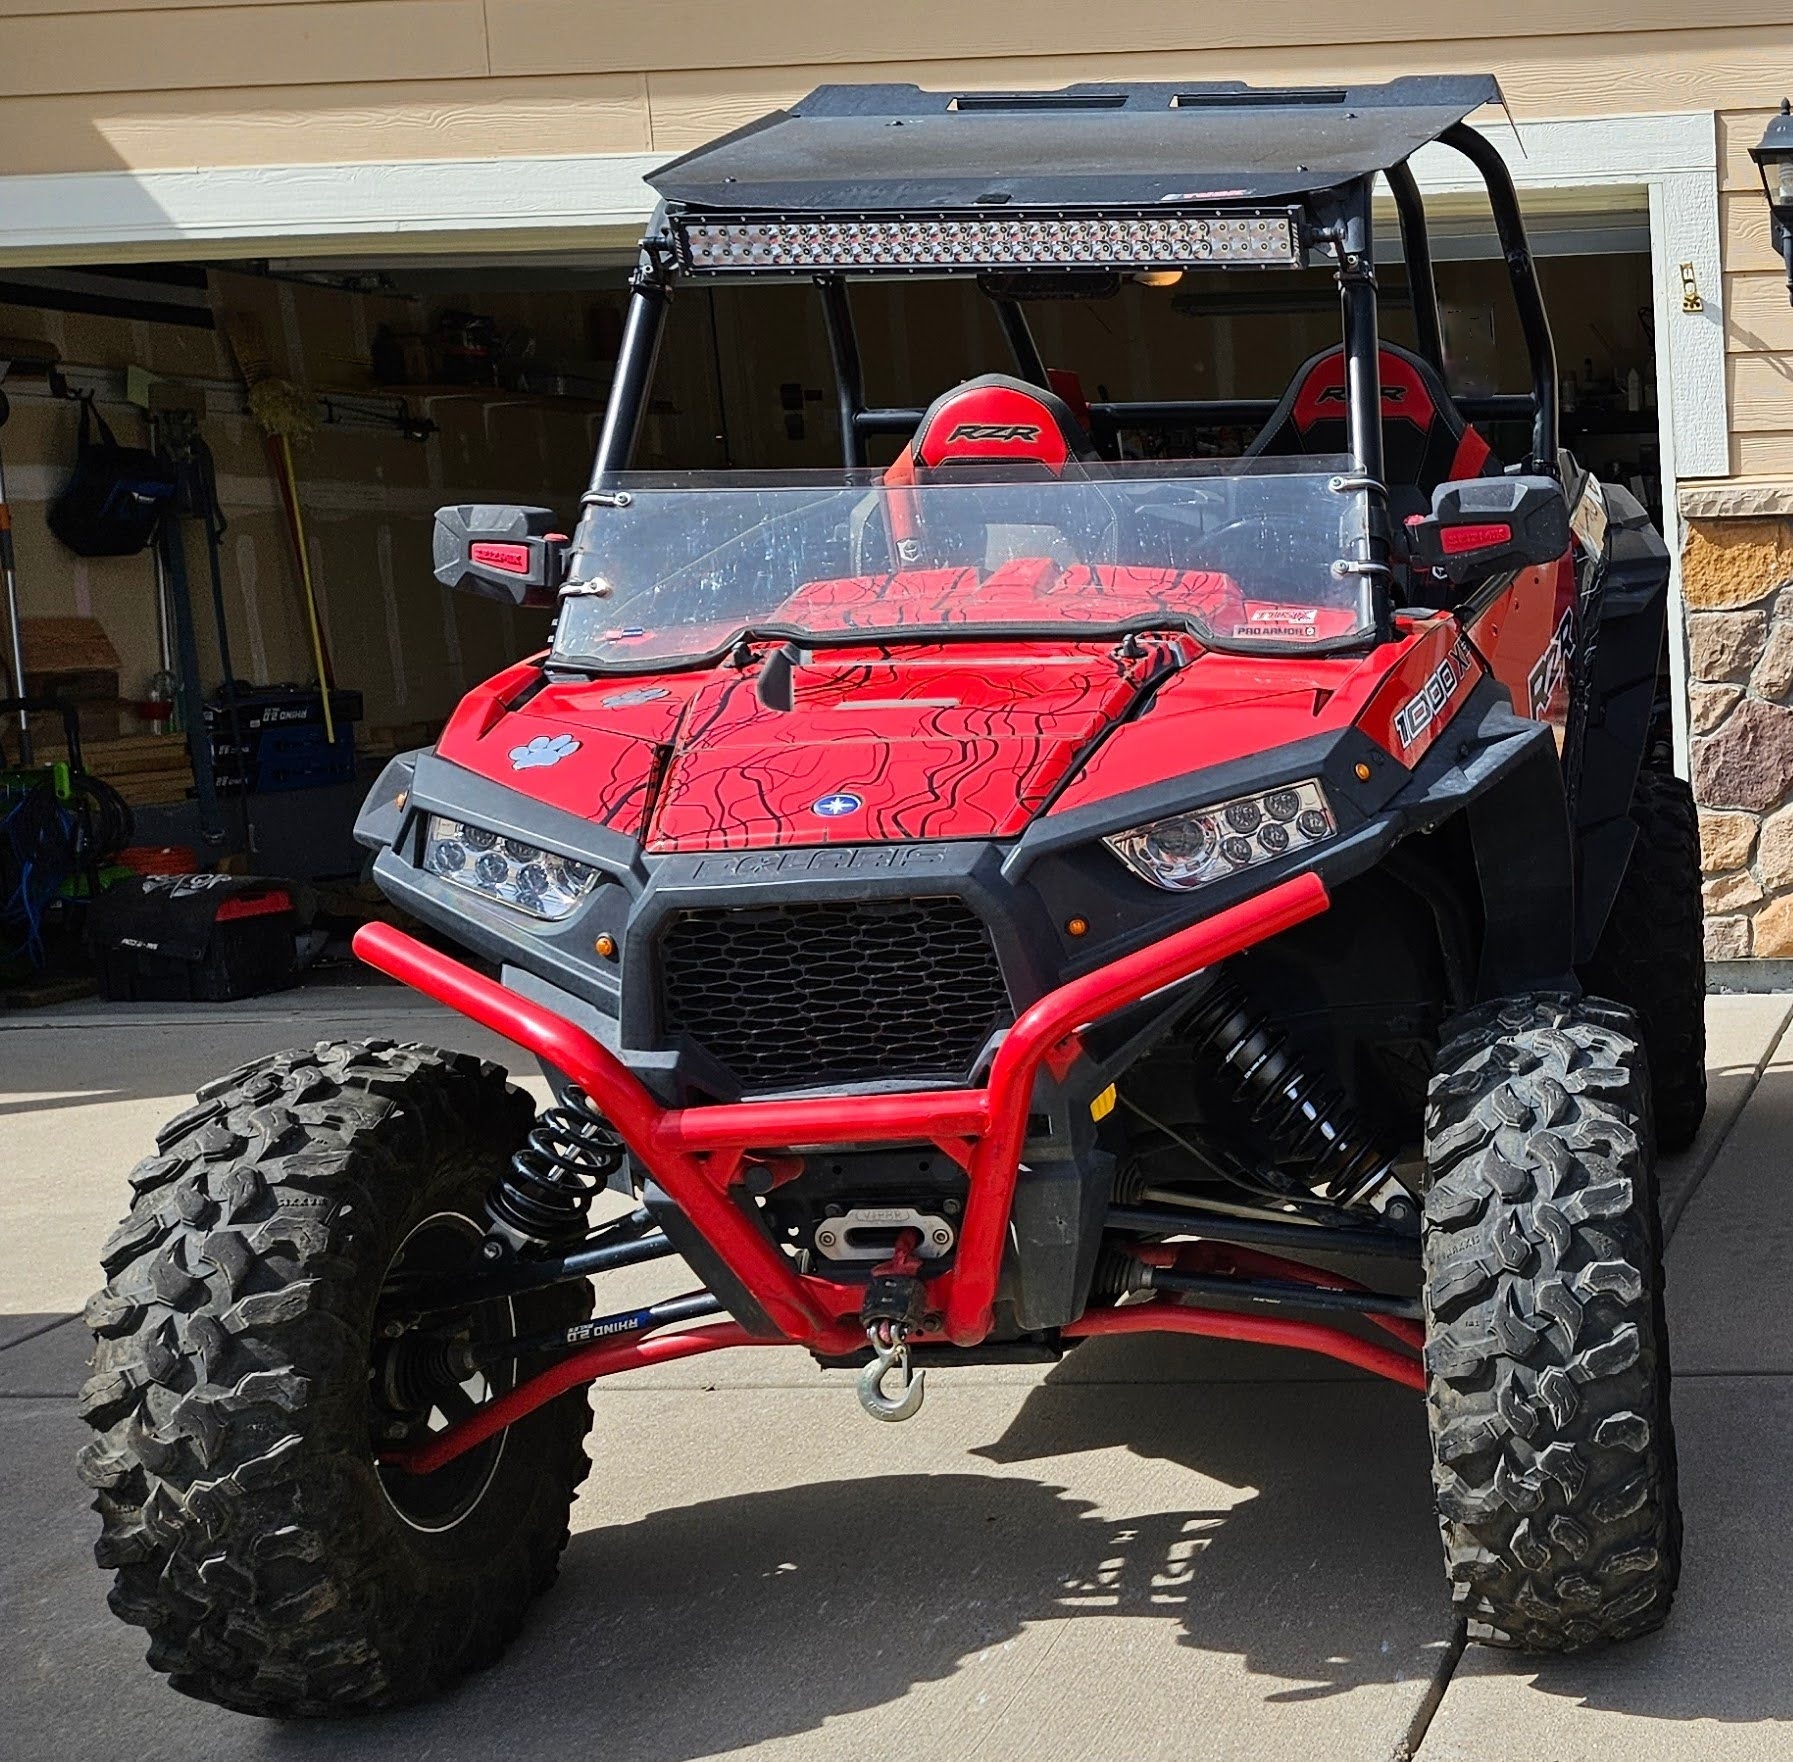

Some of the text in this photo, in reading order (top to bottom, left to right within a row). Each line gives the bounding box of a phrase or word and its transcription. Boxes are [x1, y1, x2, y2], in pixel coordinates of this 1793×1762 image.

[1315, 386, 1408, 405] RR
[946, 423, 1042, 444] RZR
[1238, 627, 1303, 637] PRO ARMOR
[1528, 605, 1576, 721] RZR
[1394, 658, 1458, 749] 1000
[693, 848, 947, 879] POLARIS
[566, 1318, 639, 1343] RHINO 2.0
